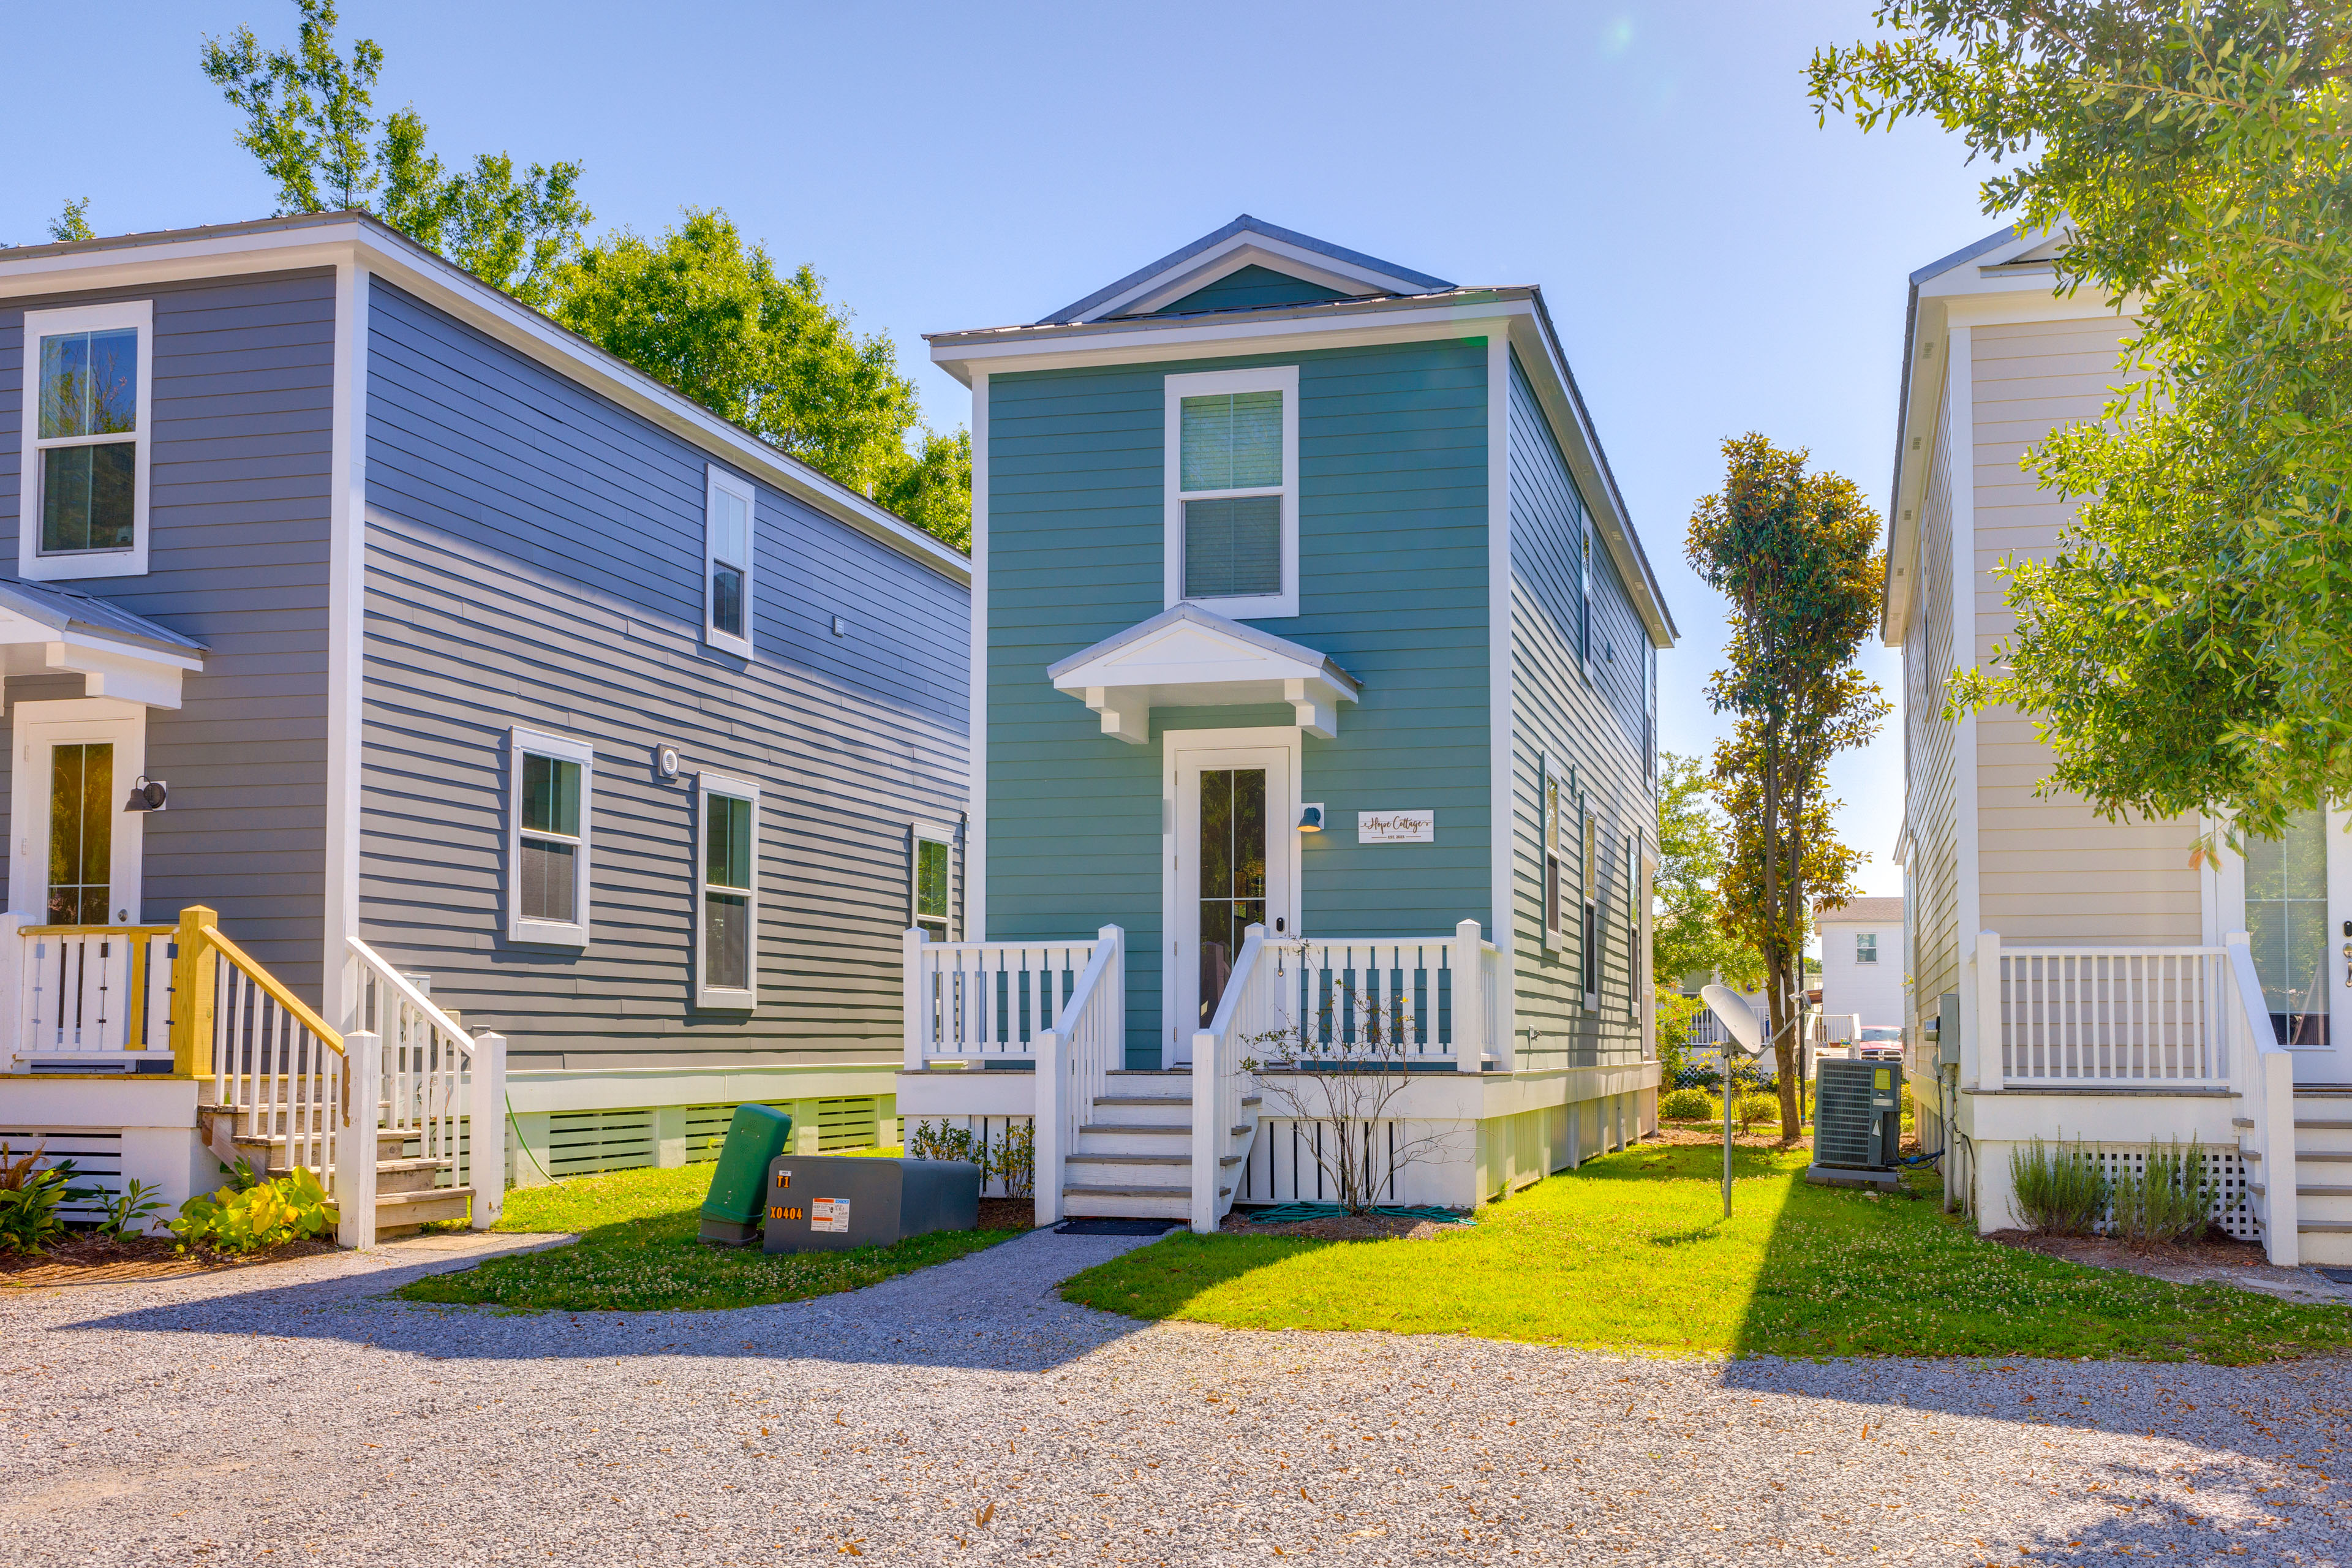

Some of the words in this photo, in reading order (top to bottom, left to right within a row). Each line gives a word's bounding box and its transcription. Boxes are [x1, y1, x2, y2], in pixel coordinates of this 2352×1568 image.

[1360, 817, 1392, 834] Hope
[1393, 816, 1433, 833] Cottage
[777, 1175, 789, 1188] T1
[770, 1207, 802, 1219] X0404
